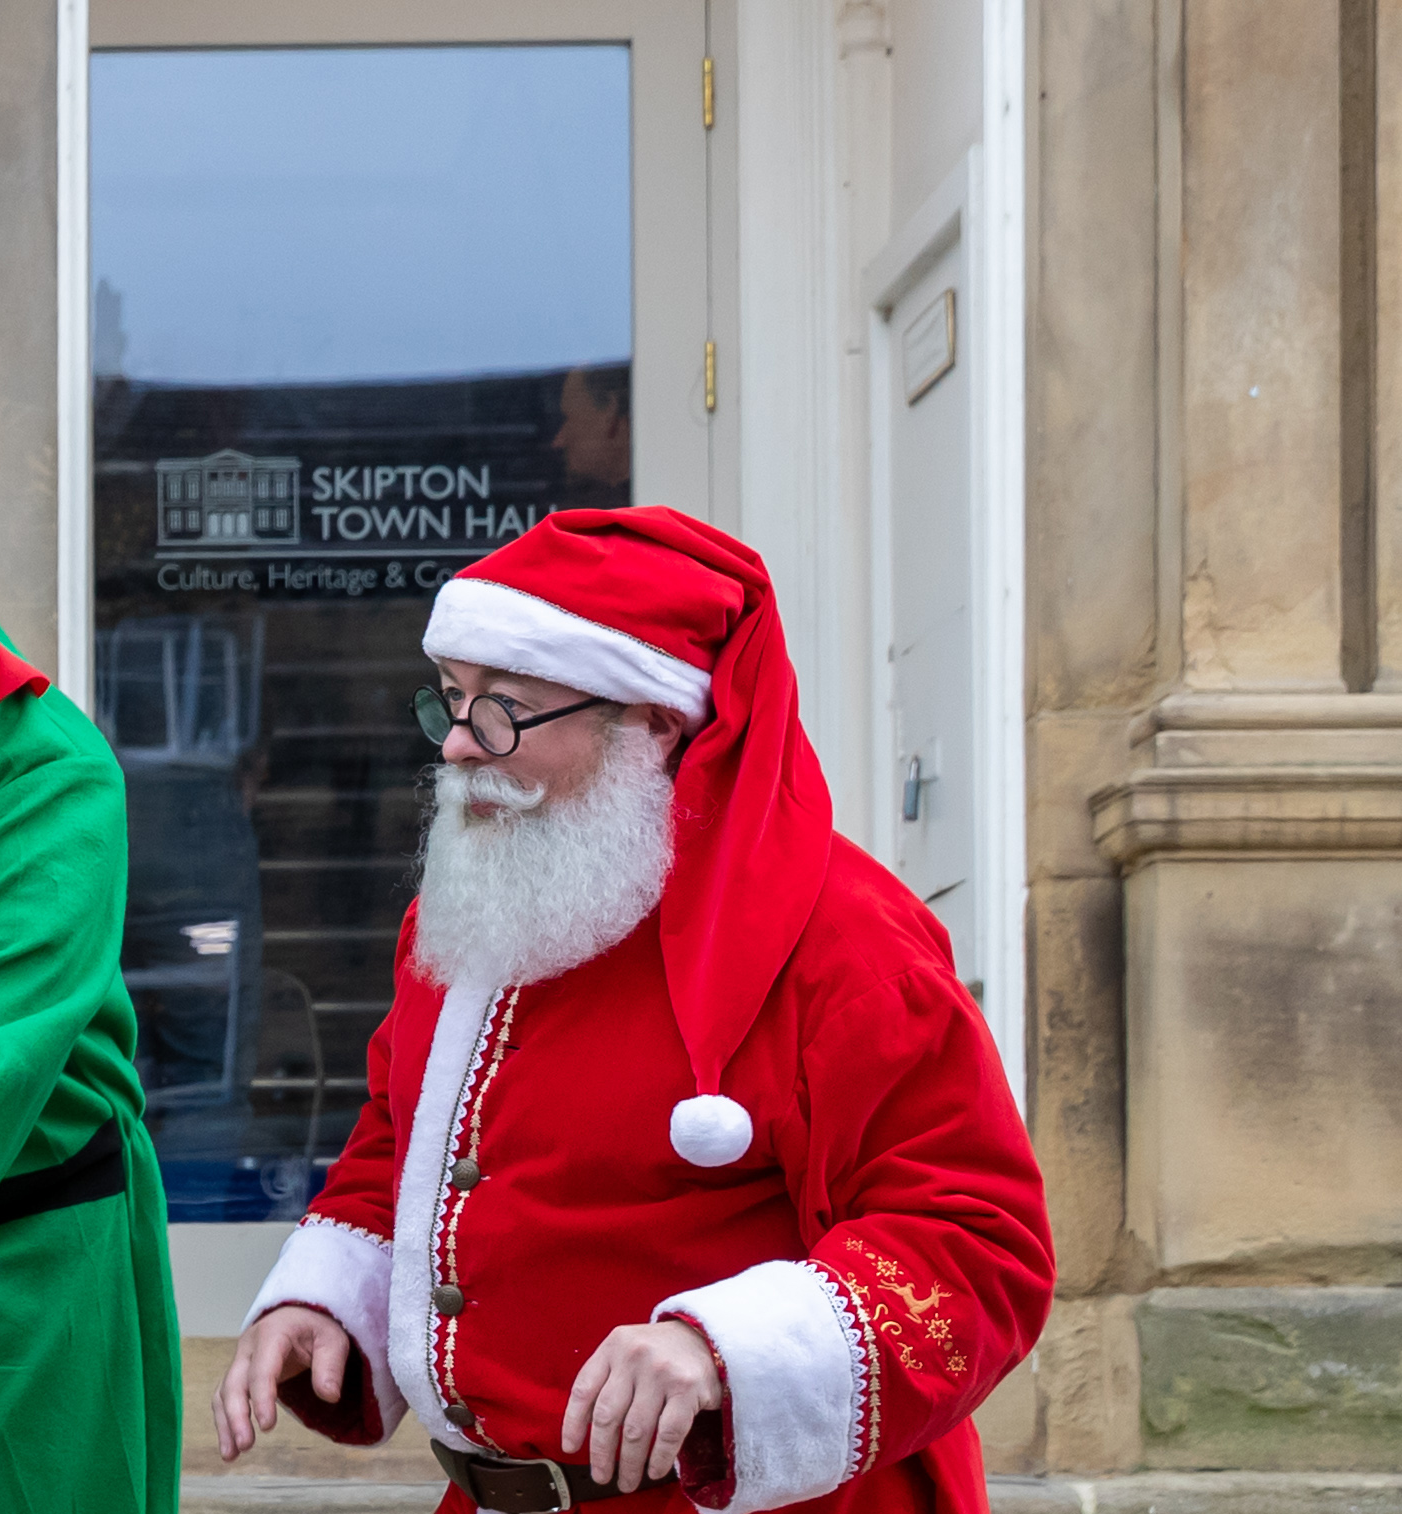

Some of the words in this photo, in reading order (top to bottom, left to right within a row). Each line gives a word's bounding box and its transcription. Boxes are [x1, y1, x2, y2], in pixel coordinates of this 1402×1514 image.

[312, 464, 490, 501] SKIPTON
[311, 504, 451, 541] TOWN
[465, 504, 556, 539] HAL
[157, 562, 261, 592] Culture,
[268, 561, 377, 597] Heritage
[385, 561, 406, 589] &
